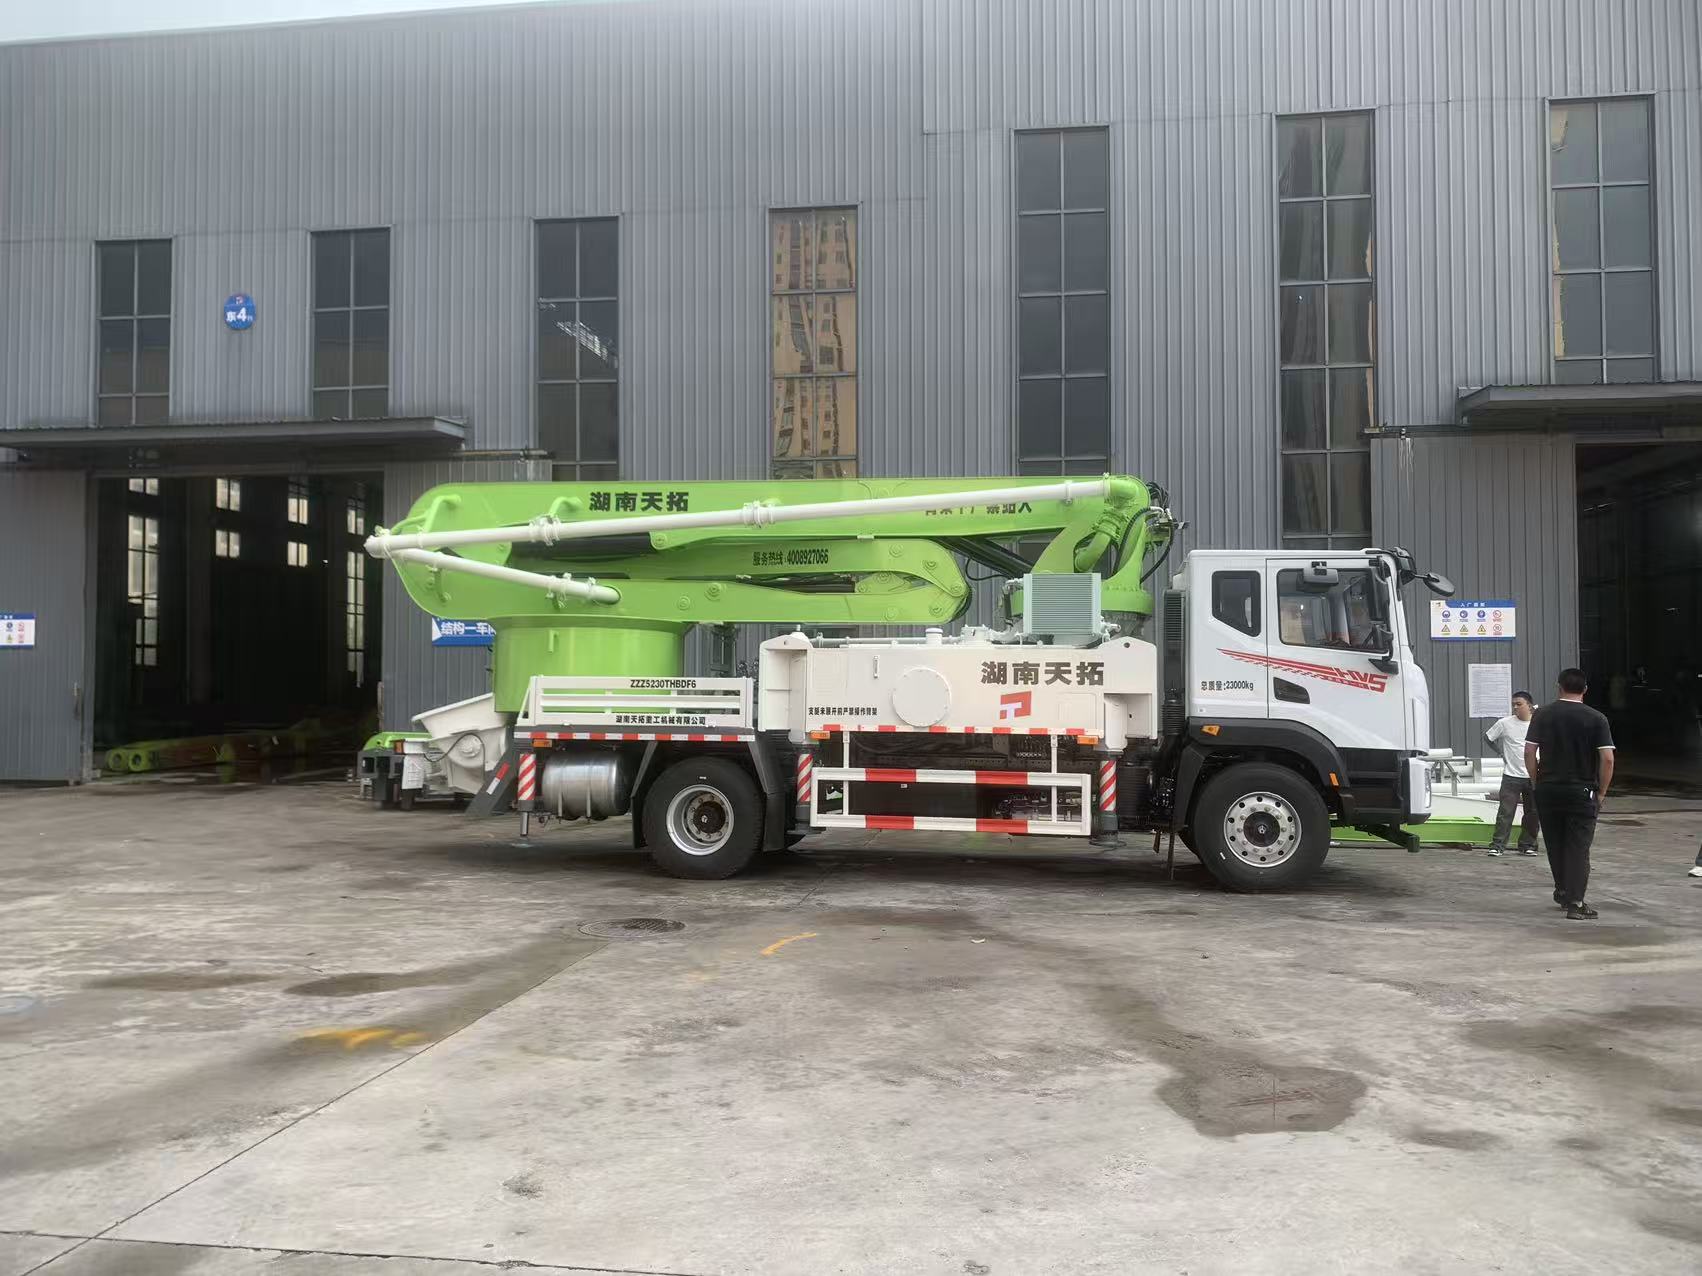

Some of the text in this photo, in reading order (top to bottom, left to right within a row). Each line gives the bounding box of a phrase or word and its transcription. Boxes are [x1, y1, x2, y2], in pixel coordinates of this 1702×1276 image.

[589, 491, 689, 512] 湖南天拓
[981, 661, 1104, 686] 湖南天拓
[630, 679, 696, 688] ZZZ5230THBDF6
[616, 715, 706, 725] 湖南天拓重工机械有限公司
